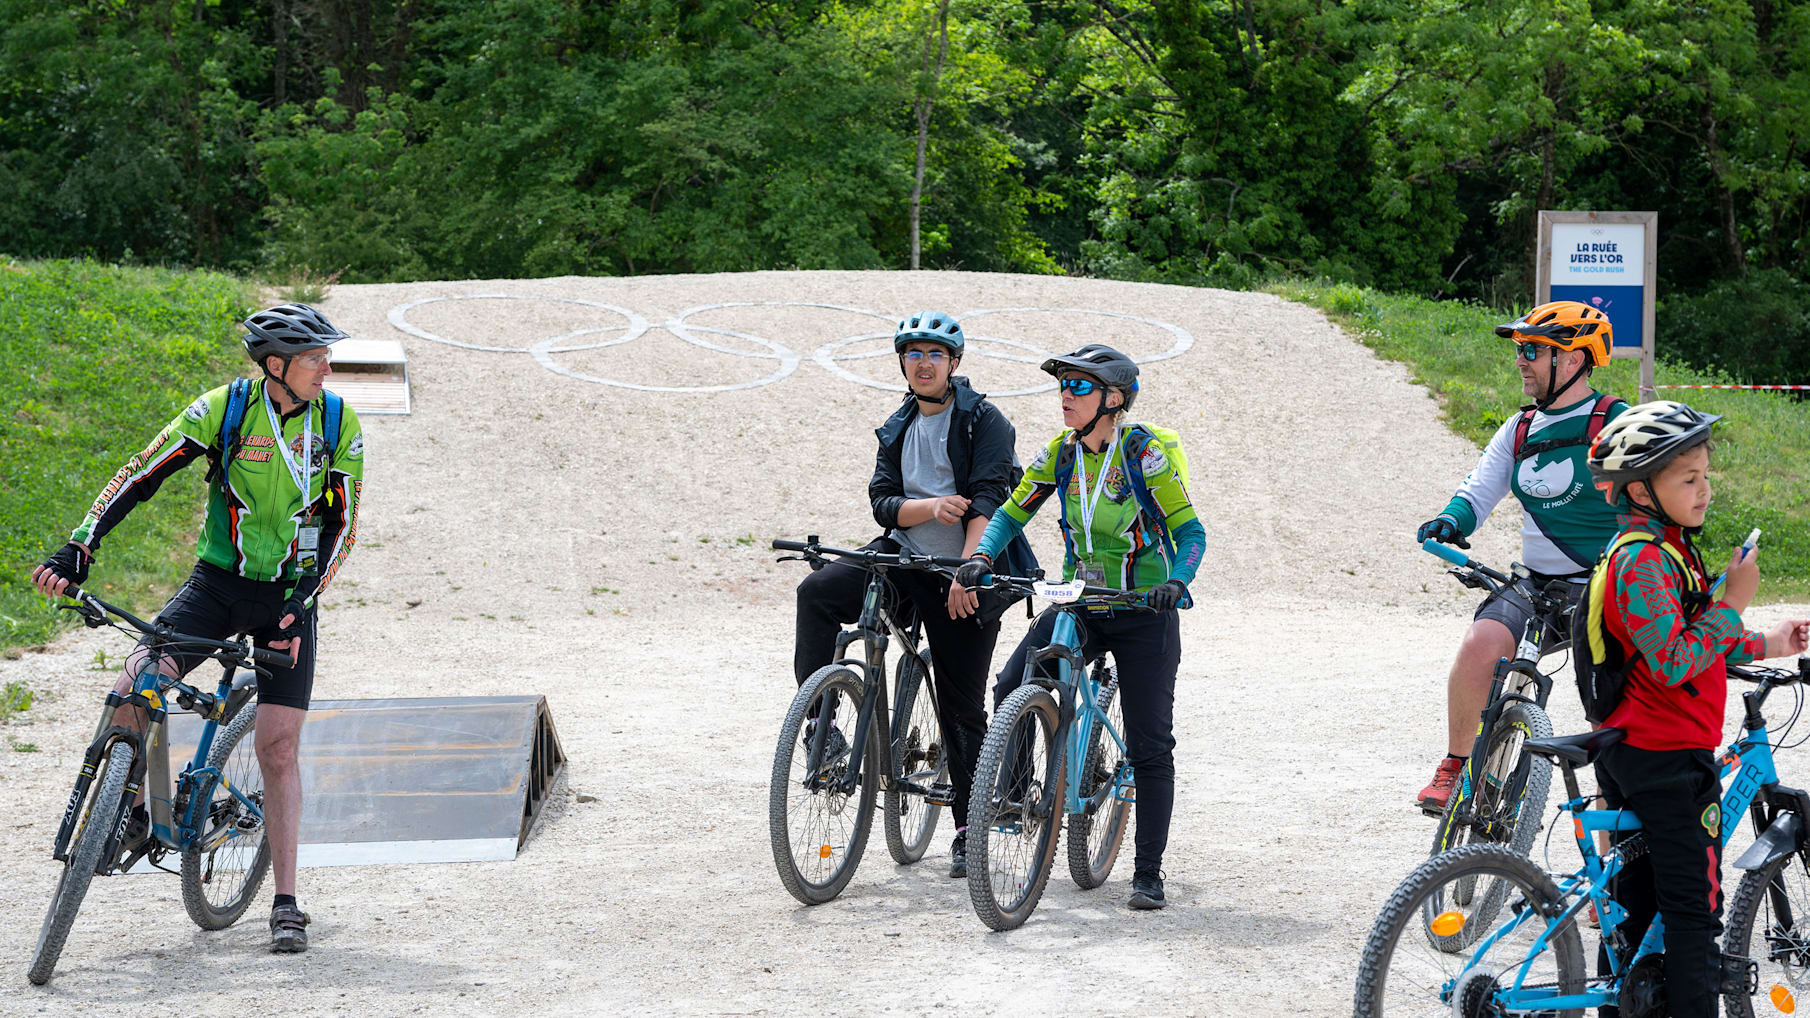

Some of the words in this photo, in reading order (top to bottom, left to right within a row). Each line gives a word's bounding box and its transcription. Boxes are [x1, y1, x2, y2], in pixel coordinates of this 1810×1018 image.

[1577, 243, 1589, 252] LA
[1592, 240, 1617, 252] RUÉE
[1570, 254, 1597, 263] VERS
[1600, 254, 1623, 263] L'OR
[246, 450, 274, 462] MANET
[1551, 494, 1573, 508] MOLLET
[89, 500, 105, 520] LES
[65, 789, 81, 825] FOX
[115, 805, 131, 841] FOX
